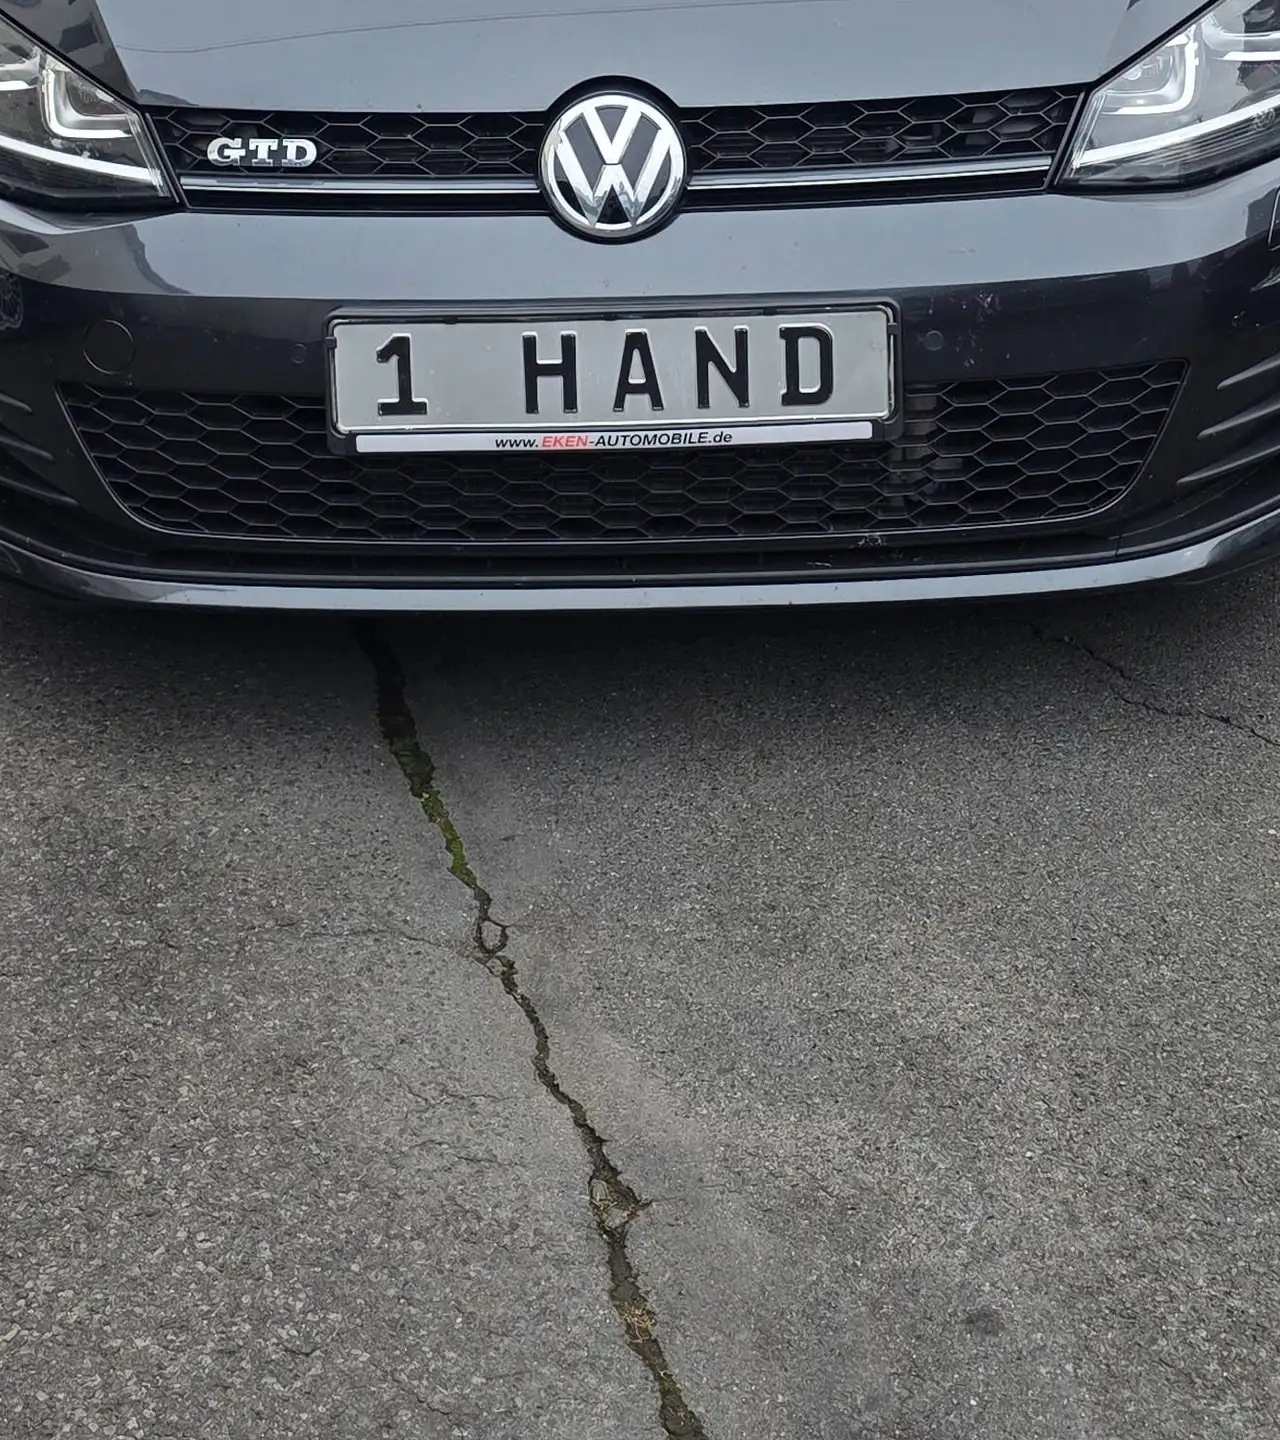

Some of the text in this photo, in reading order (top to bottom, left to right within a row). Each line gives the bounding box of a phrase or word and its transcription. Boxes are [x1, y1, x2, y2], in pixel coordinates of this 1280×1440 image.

[206, 136, 318, 168] GTD
[373, 324, 836, 416] 1 HAND
[494, 431, 734, 449] www.EKEN-AUTOMOBILE.de
